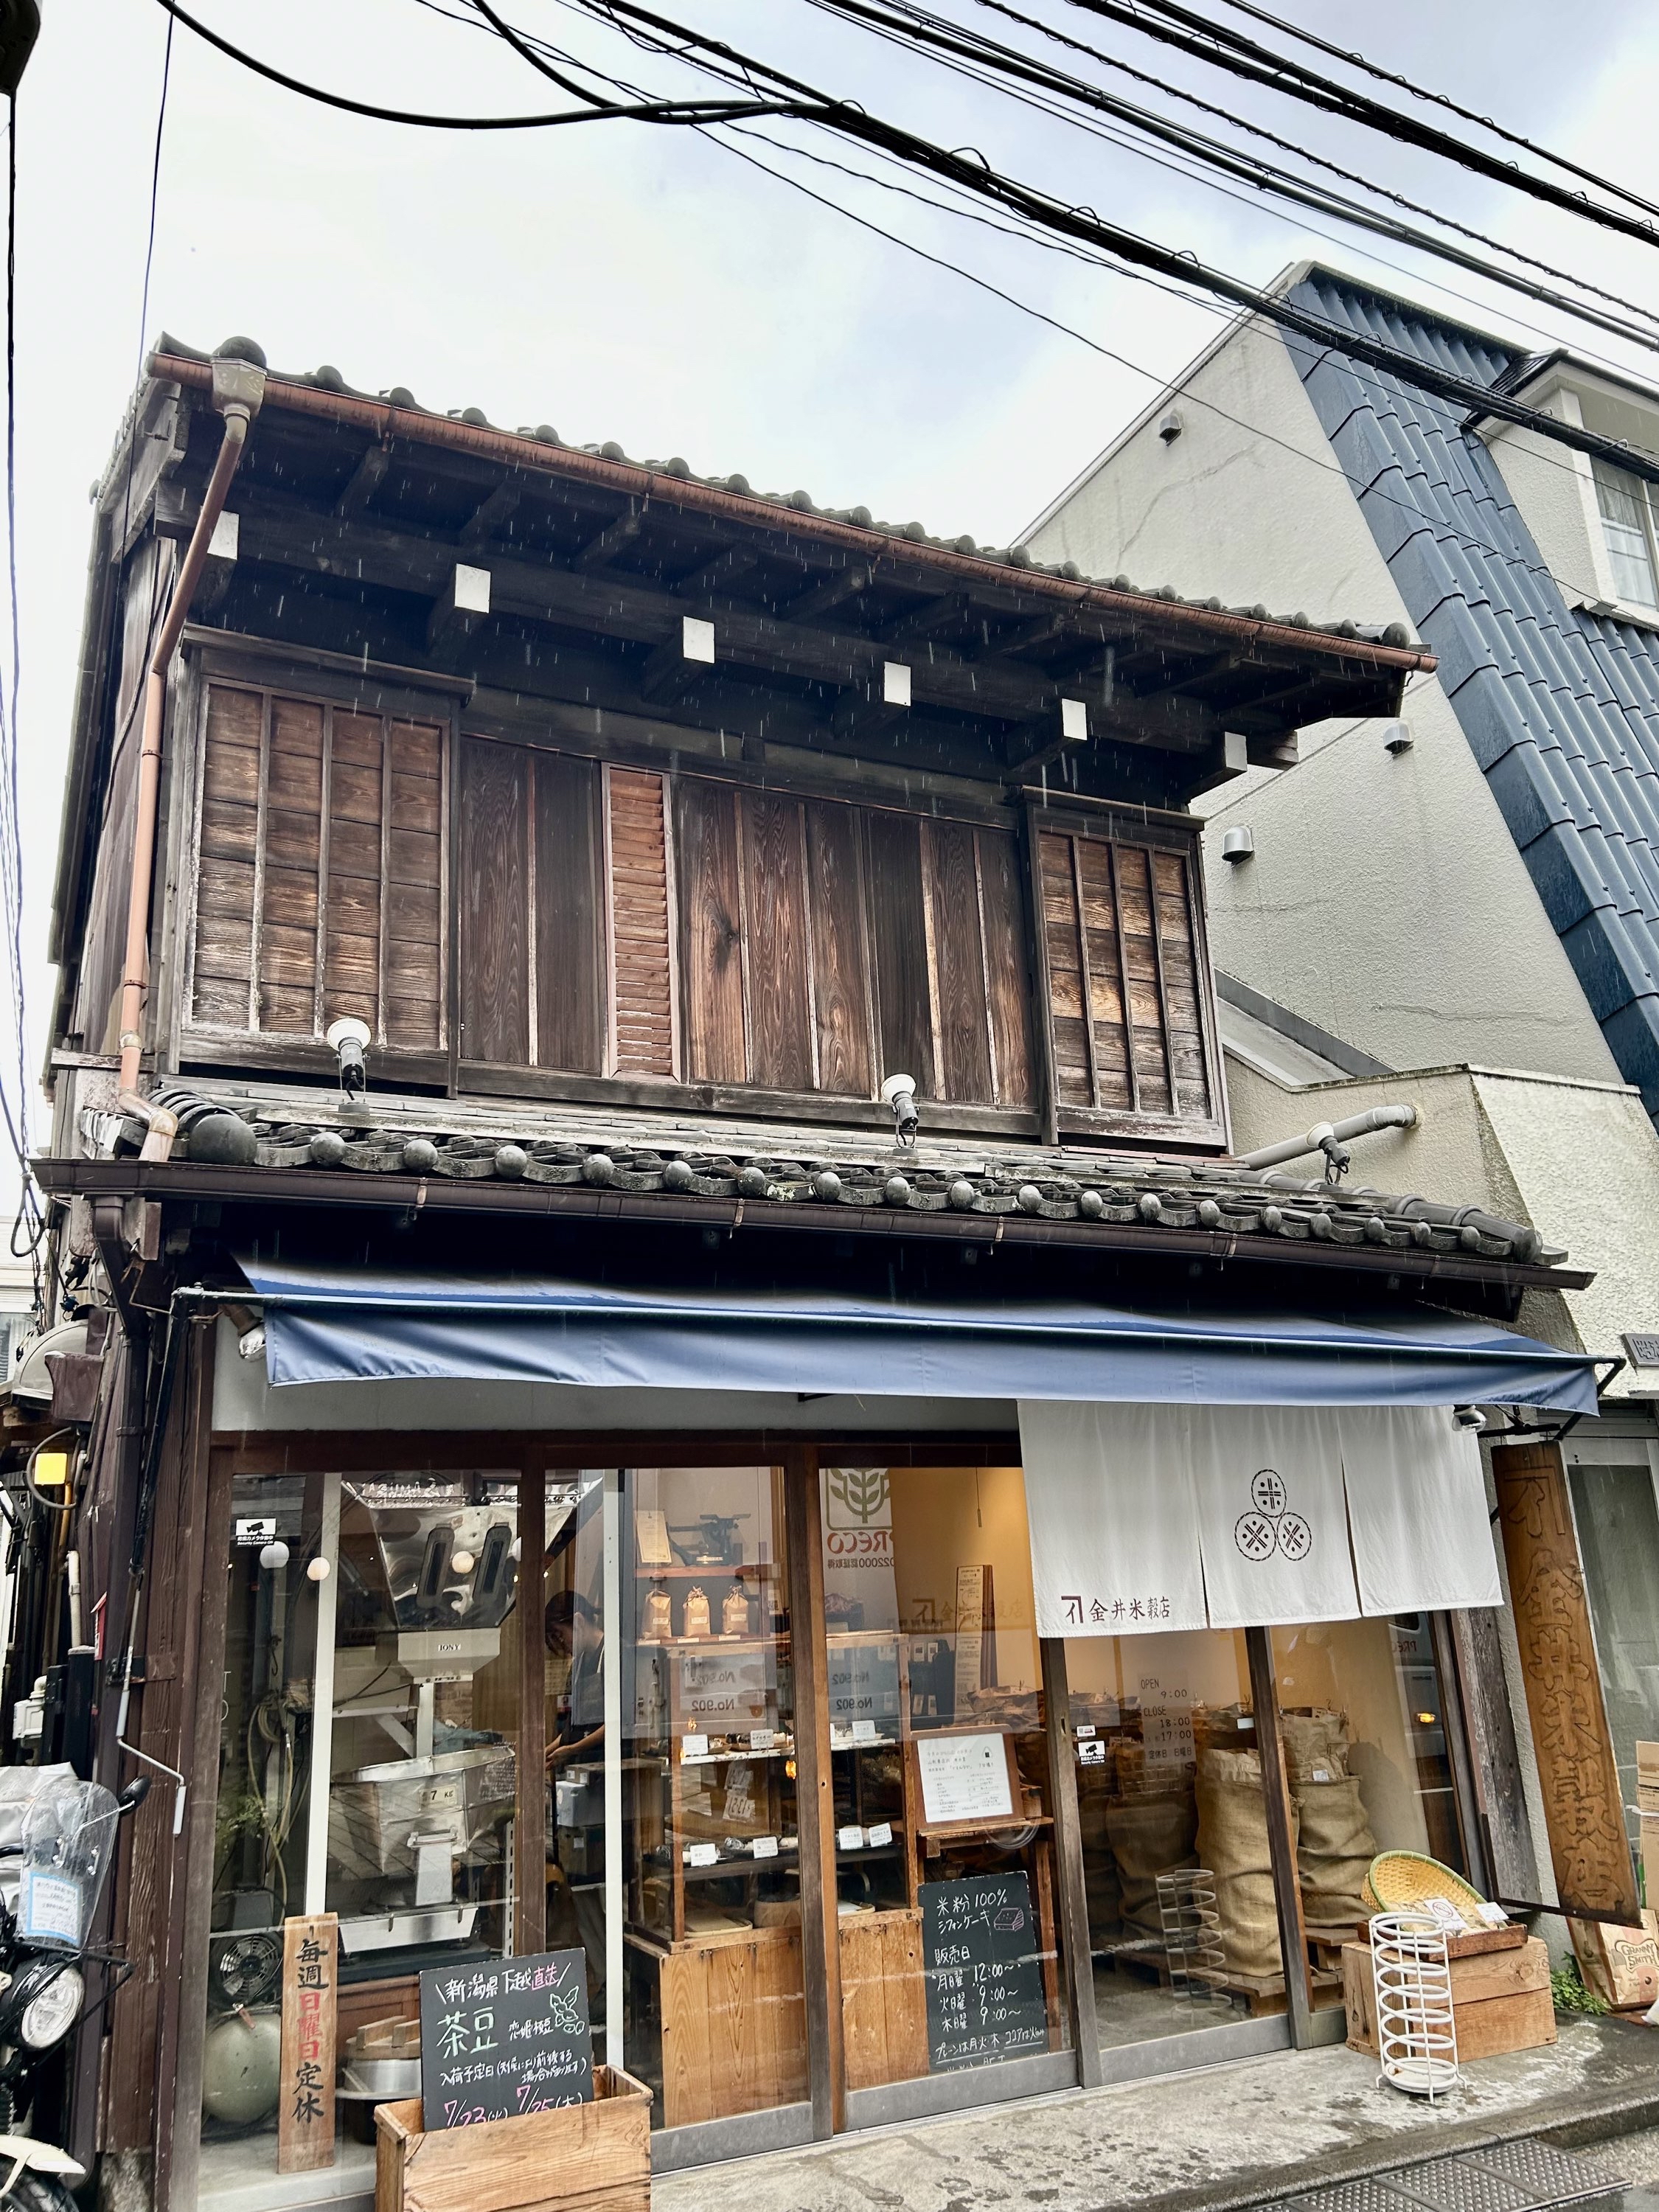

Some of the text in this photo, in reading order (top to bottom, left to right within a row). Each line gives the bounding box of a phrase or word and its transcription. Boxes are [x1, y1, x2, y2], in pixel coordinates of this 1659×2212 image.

[1088, 1596, 1171, 1622] 金井米穀店
[1141, 1679, 1160, 1690] OPEN
[1161, 1688, 1187, 1699] 9:00
[1144, 1705, 1166, 1717] CLOSE
[1160, 1717, 1190, 1728] 18:00
[1519, 1548, 1624, 1913] 金井米穀店
[1149, 1749, 1167, 1760] 定休日
[938, 1908, 990, 1935] シフォンケーキ
[934, 1944, 970, 1966] 販売日
[1621, 1943, 1655, 1956] GRANNY
[1627, 1954, 1658, 1970] SMITH
[292, 1938, 330, 2124] 毎週日曜日定休
[437, 2006, 499, 2059] 茶豆
